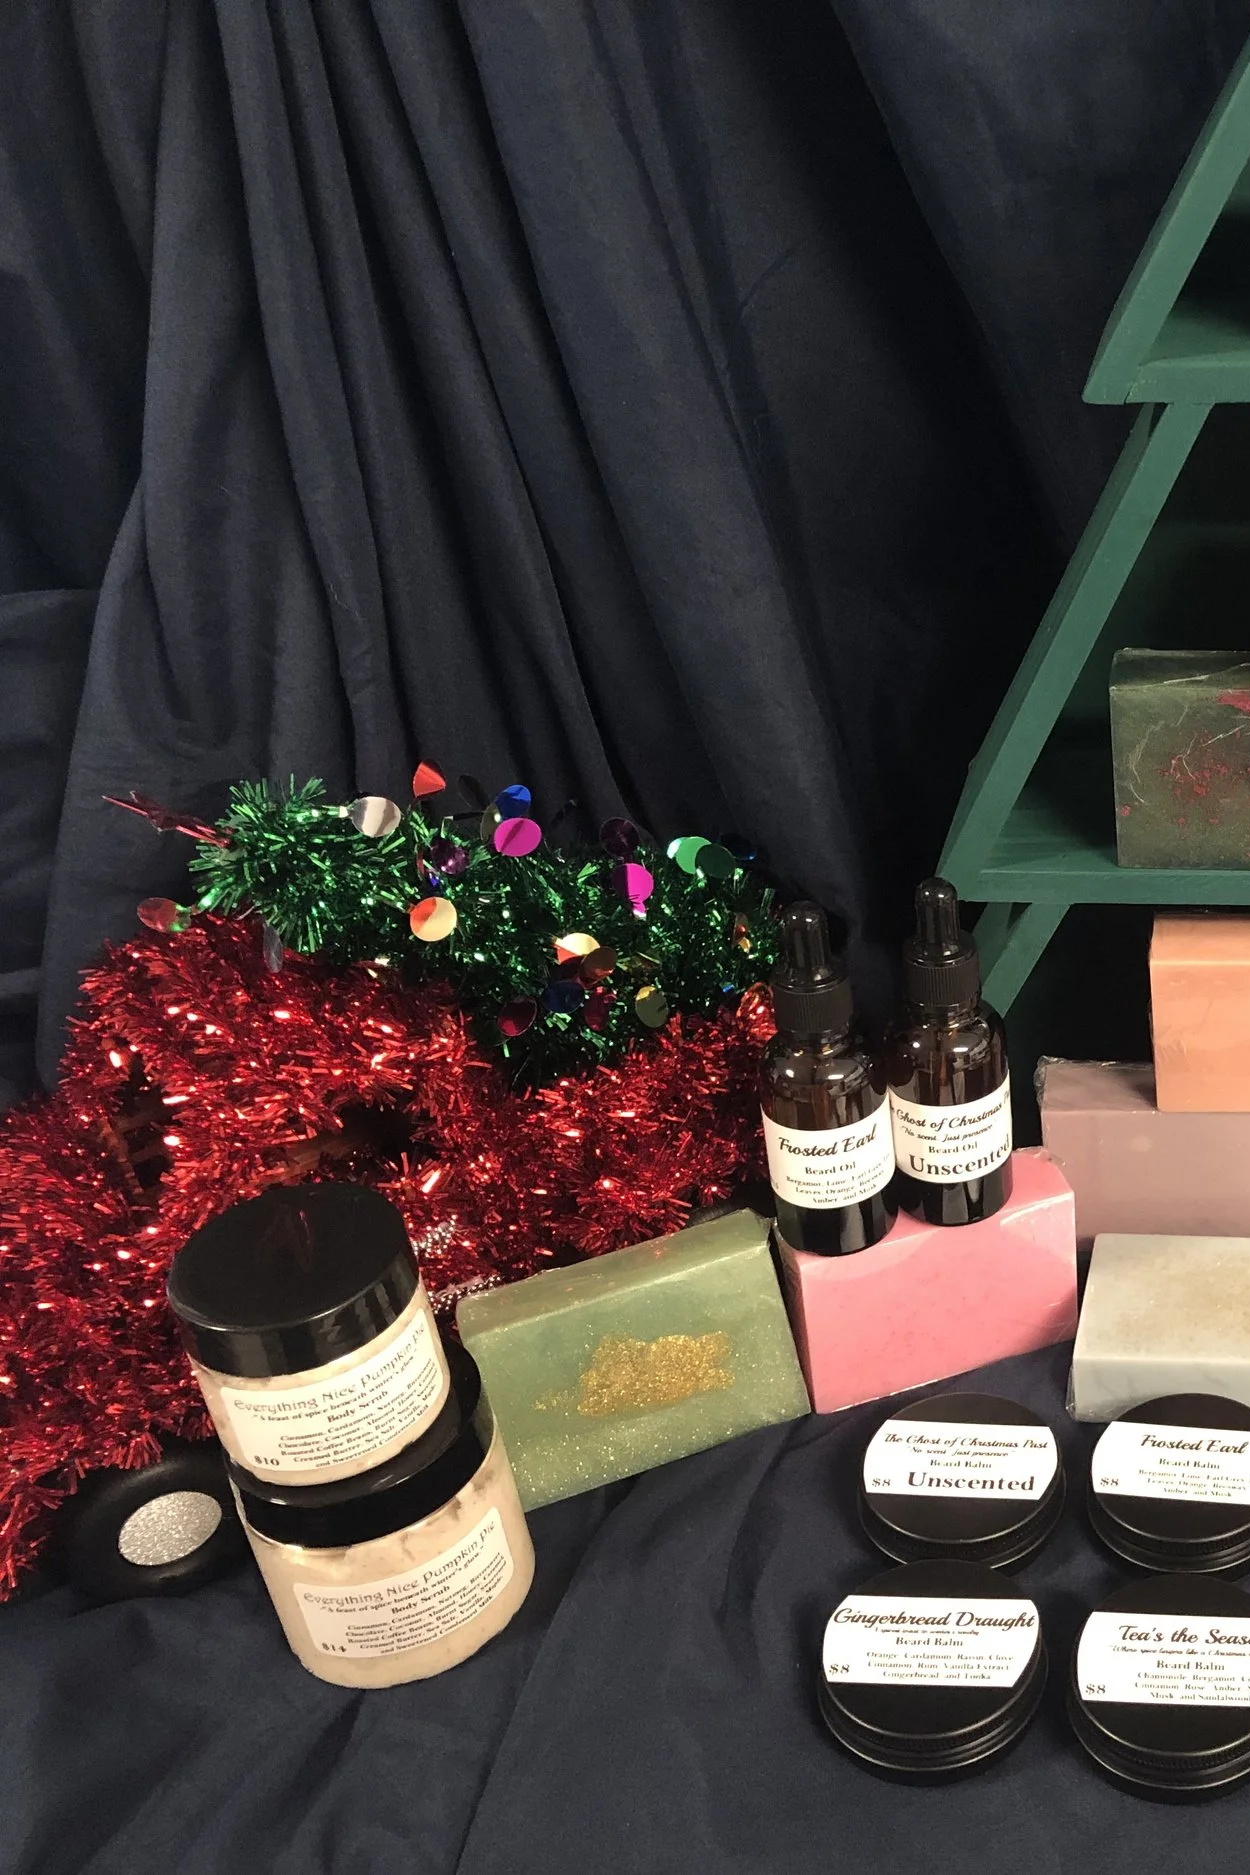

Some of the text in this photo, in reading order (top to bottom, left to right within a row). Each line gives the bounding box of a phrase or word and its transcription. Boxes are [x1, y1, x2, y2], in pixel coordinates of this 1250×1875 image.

[896, 1102, 1002, 1132] Ghost of Christmas
[778, 1123, 877, 1157] Frosted Earl
[928, 1141, 978, 1154] Beard Oil
[909, 1133, 1010, 1176] Unscented
[805, 1161, 856, 1175] Beard Oil
[234, 1398, 318, 1414] Everything
[322, 1384, 357, 1403] Nice
[360, 1342, 412, 1388] Pumpkin
[327, 1390, 388, 1423] Body Scrub
[884, 1433, 1048, 1449] The Ghost of Christmas Past
[1140, 1434, 1249, 1454] Frosted Earl
[254, 1455, 280, 1466] $10
[930, 1459, 992, 1468] Beard Balm
[1159, 1458, 1220, 1470] Beard Balm
[872, 1471, 1035, 1491] $8 Unscented
[1100, 1477, 1119, 1487] $8
[303, 1591, 384, 1607] Everything
[386, 1580, 419, 1597] Nice
[422, 1540, 478, 1583] Pumpkin
[391, 1586, 450, 1615] Body Scrub
[833, 1607, 952, 1629] Gingerbread
[956, 1611, 1035, 1632] Draught
[382, 1631, 406, 1640] Coffee
[896, 1637, 963, 1646] Beard Balm
[1119, 1625, 1164, 1642] Tea's
[1171, 1627, 1198, 1643] the
[829, 1663, 850, 1675] $8
[1157, 1660, 1225, 1670] Beard Balm
[1085, 1683, 1106, 1695] $8
